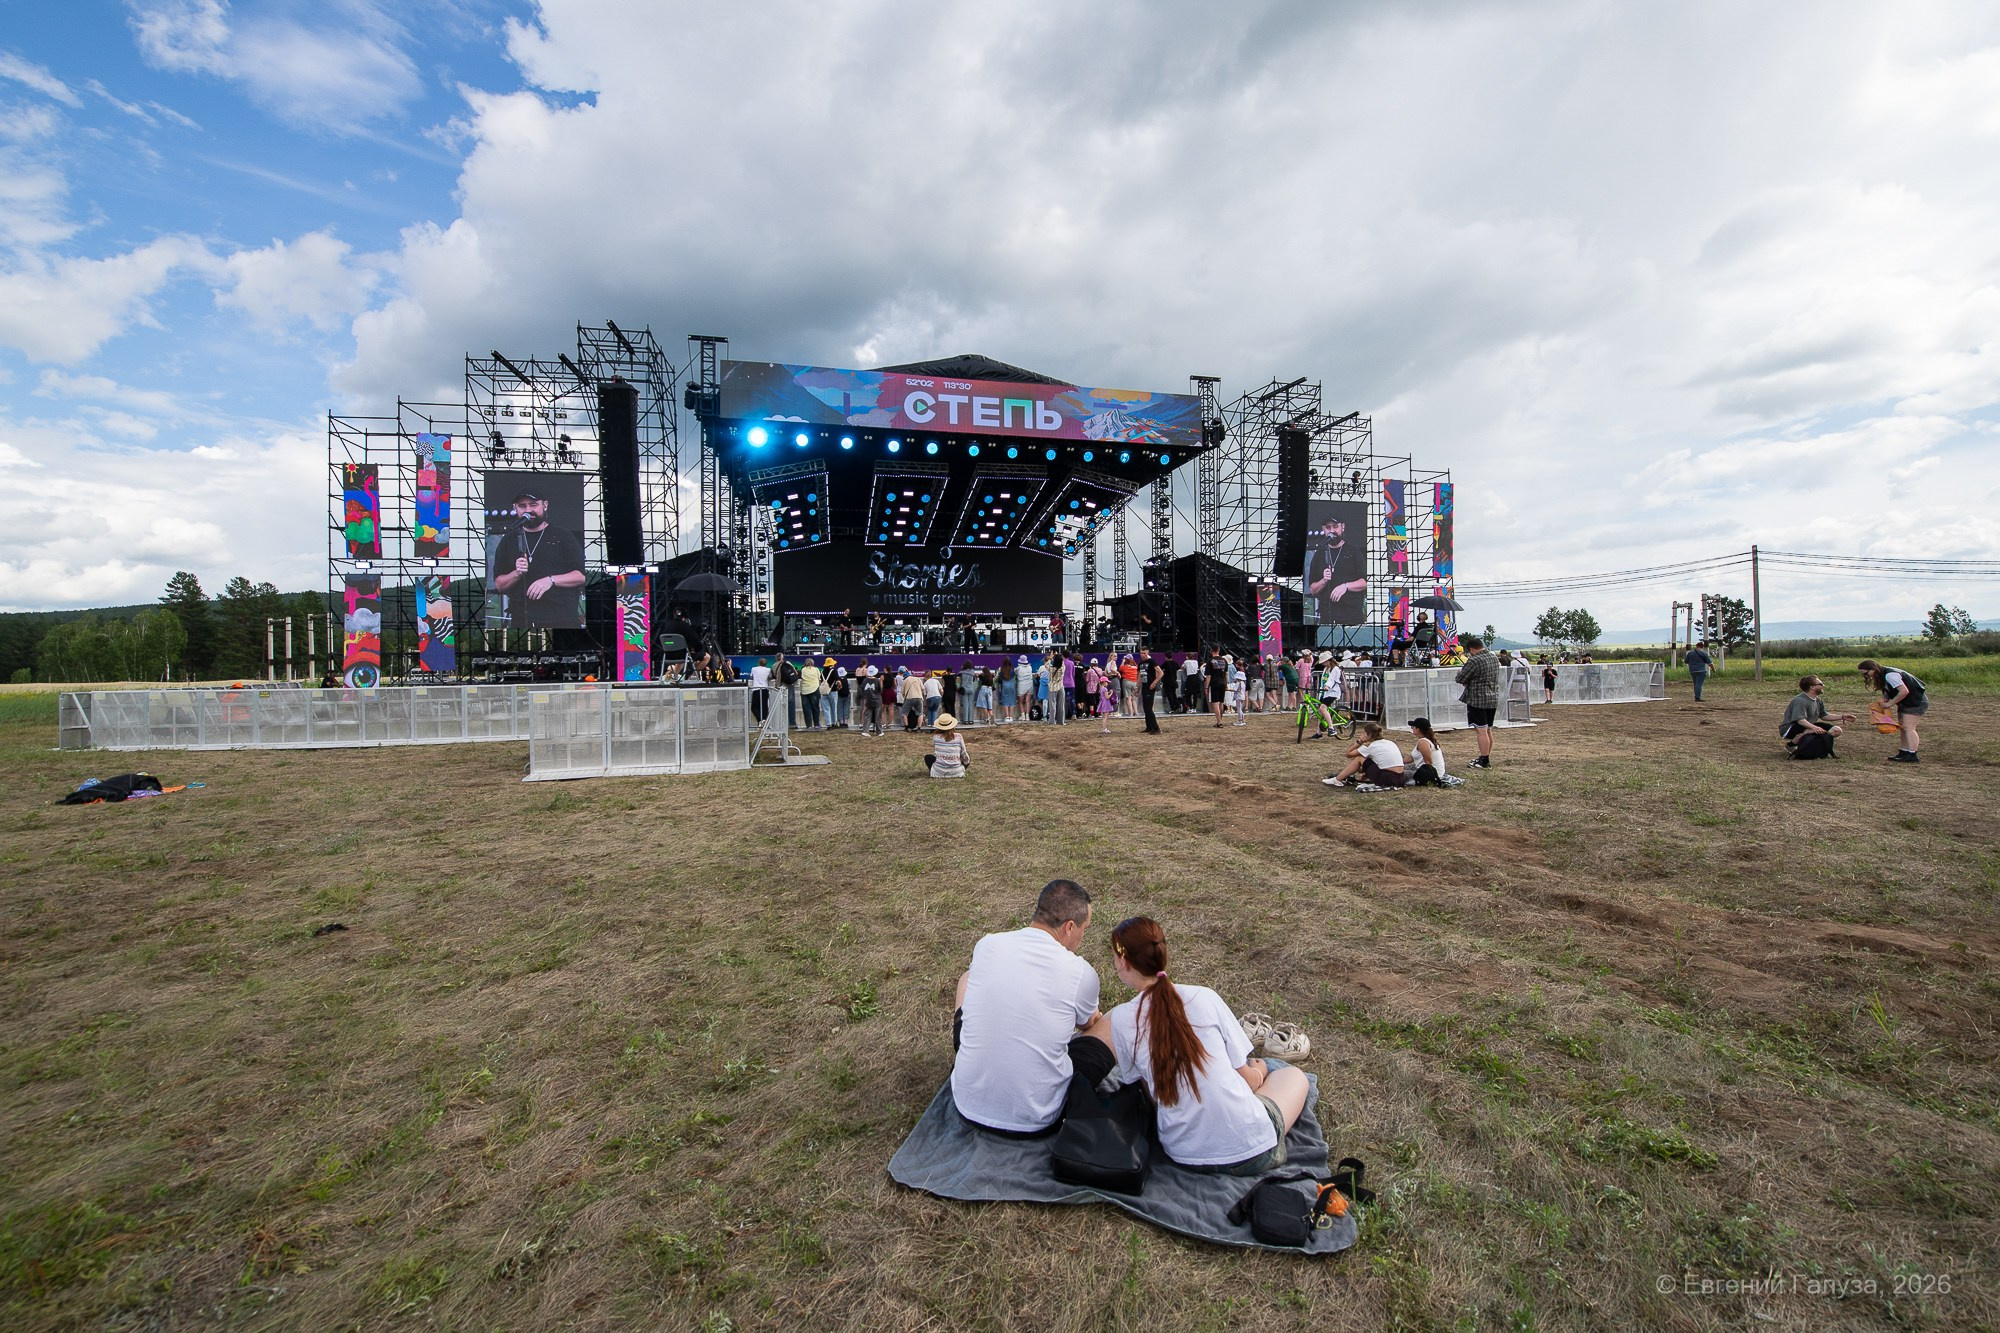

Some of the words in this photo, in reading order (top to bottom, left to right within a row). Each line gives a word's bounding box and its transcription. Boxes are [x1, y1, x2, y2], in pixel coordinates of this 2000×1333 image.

[903, 390, 1063, 431] СТЕПЬ
[864, 546, 984, 589] Stories
[883, 591, 928, 605] music
[932, 593, 976, 609] group
